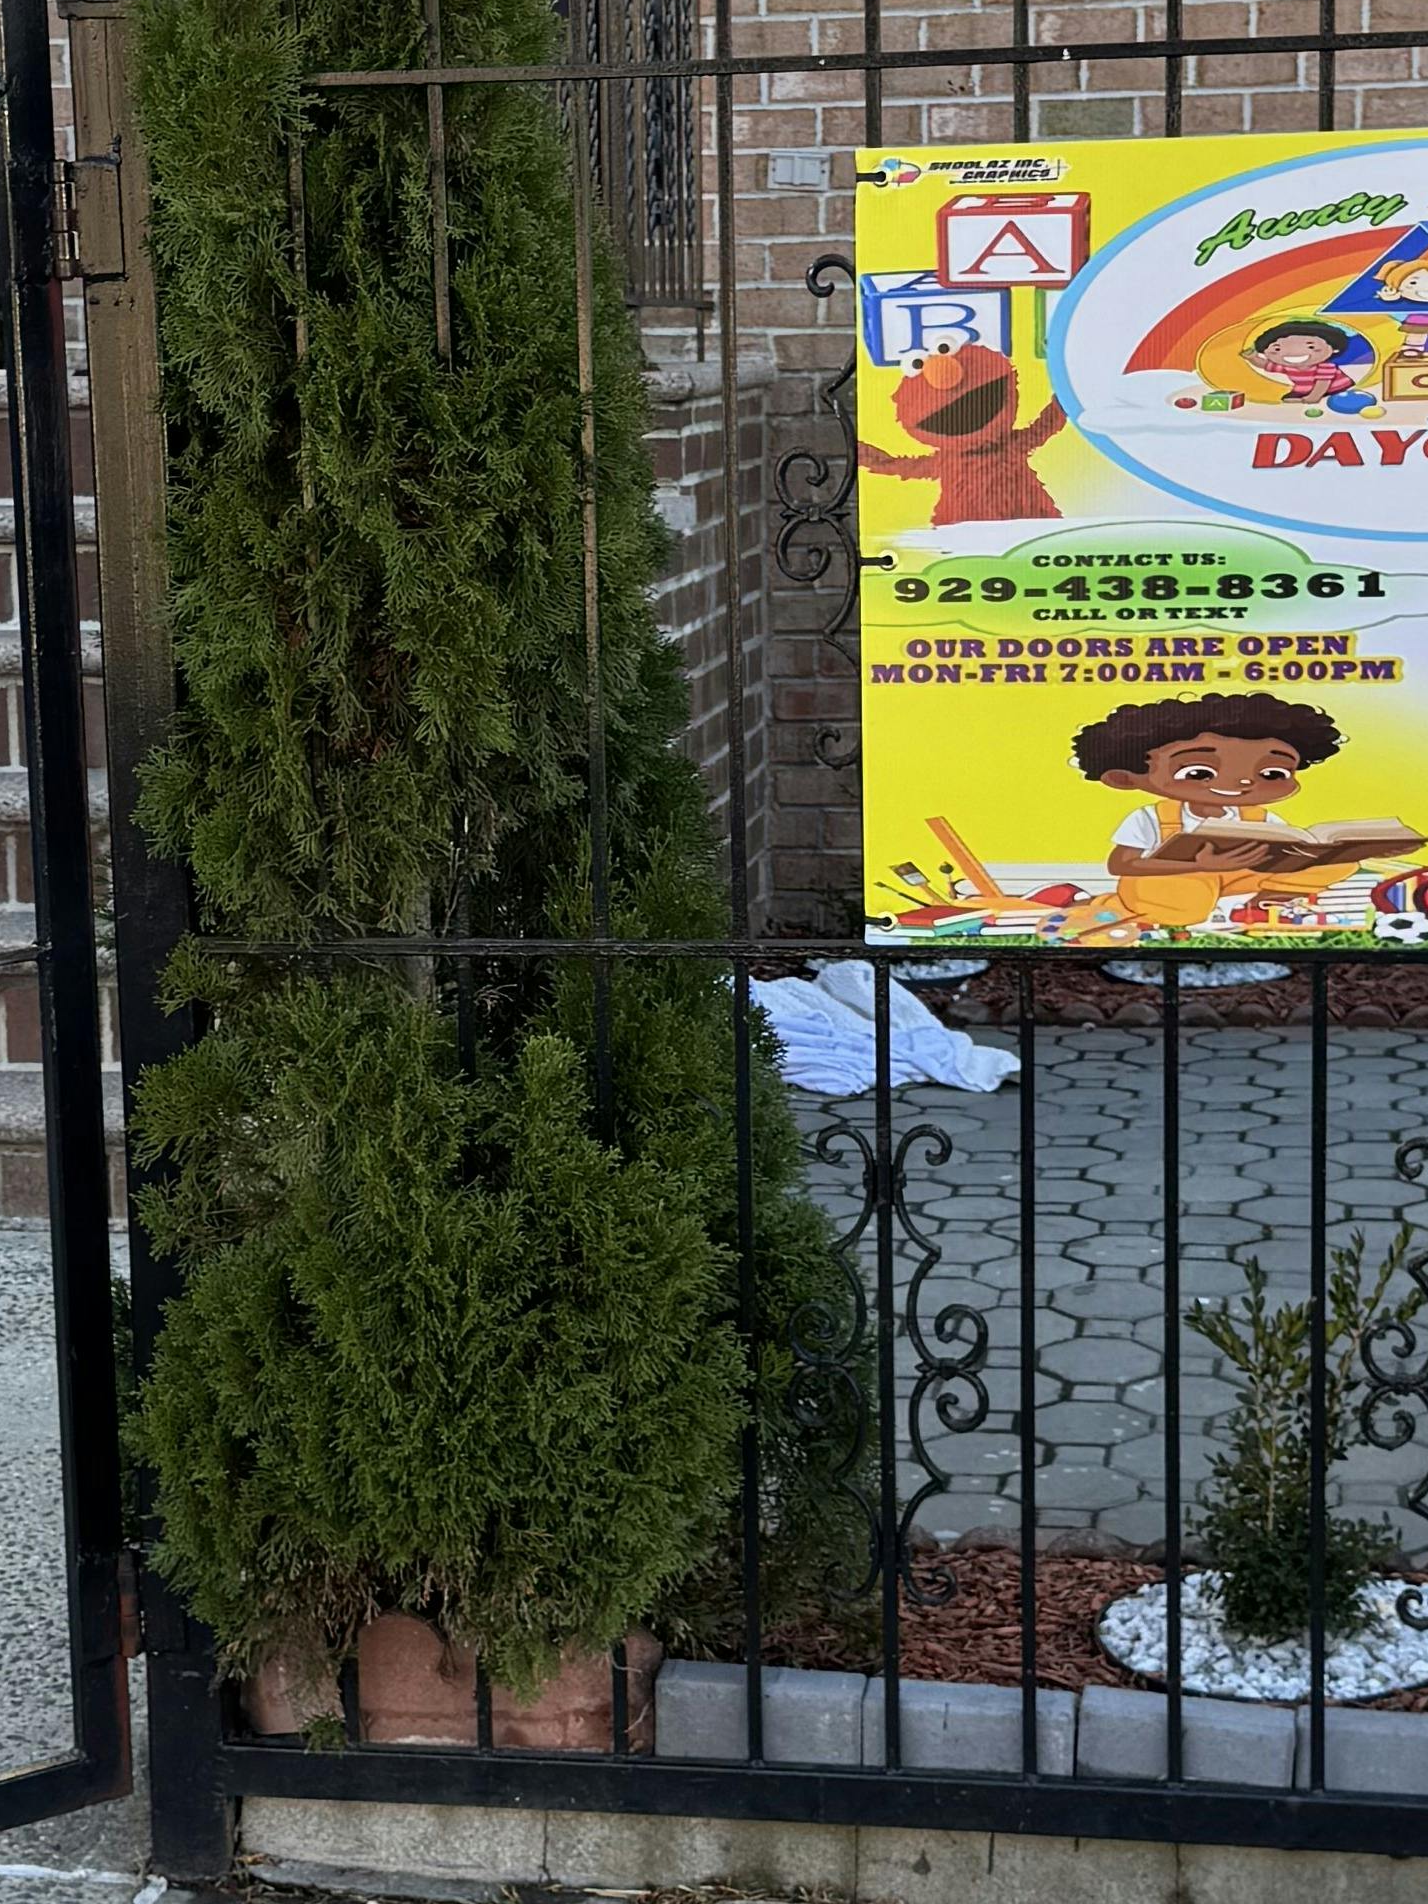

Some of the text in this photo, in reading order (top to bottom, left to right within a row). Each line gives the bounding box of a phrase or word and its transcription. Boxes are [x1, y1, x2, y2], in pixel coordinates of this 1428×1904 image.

[1194, 191, 1409, 266] Aunty
[957, 220, 1067, 275] A
[1032, 552, 1226, 568] CONTACT US:
[893, 572, 1386, 604] 929-438-8361
[1032, 606, 1248, 622] CALL OR TEXT
[906, 634, 1350, 660] OUR DOORS ARE OPEN
[871, 663, 1048, 684] MON-FRI
[1060, 662, 1206, 683] 7:00AM
[1244, 660, 1397, 681] 6:00PM
